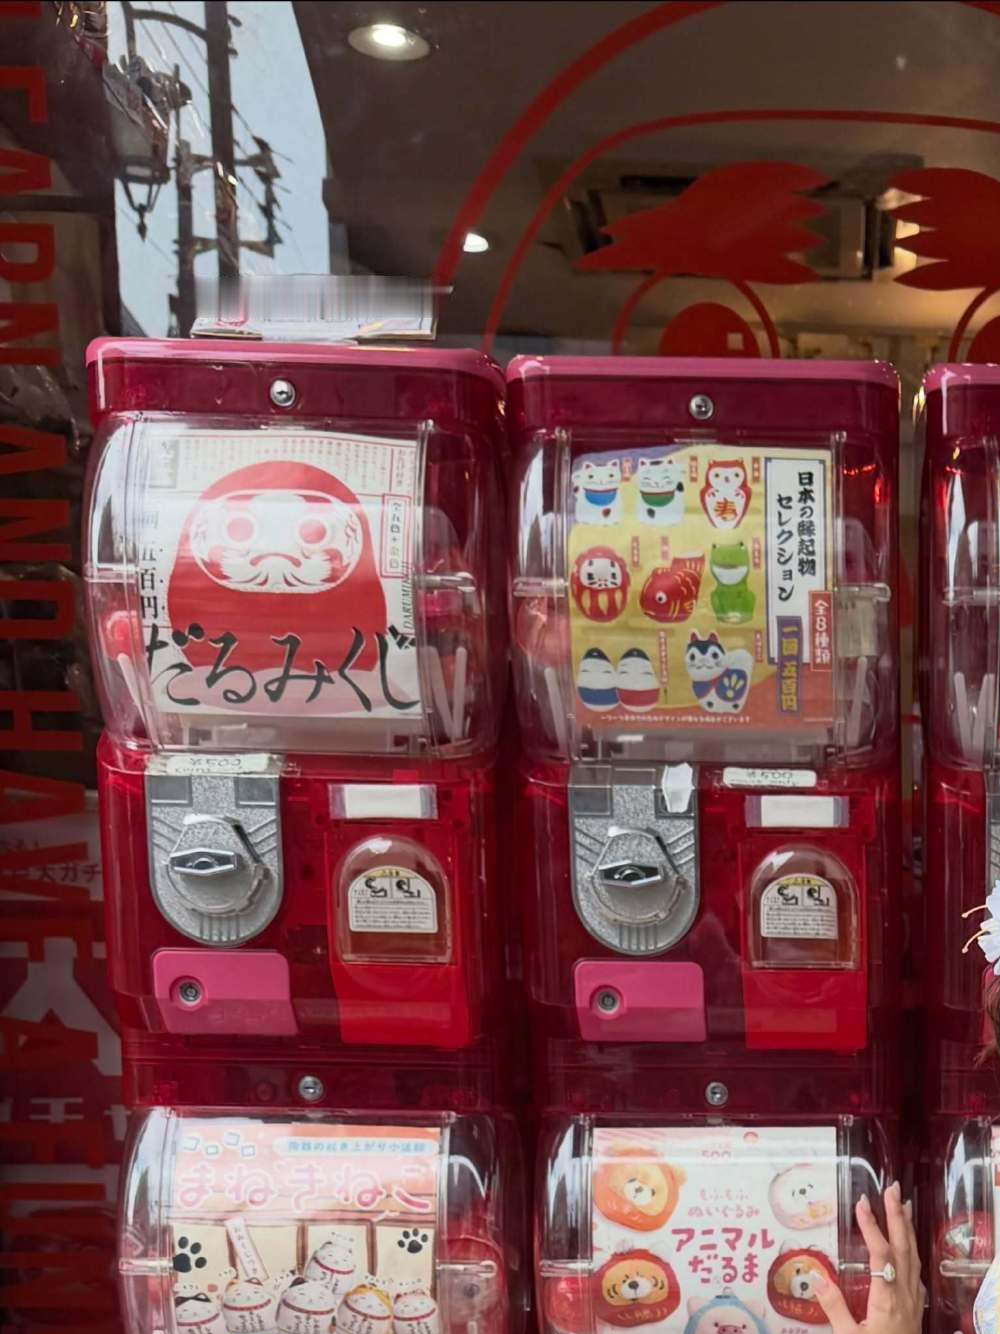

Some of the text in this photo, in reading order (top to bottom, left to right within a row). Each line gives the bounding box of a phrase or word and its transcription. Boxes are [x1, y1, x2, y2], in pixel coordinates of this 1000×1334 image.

[777, 493, 795, 602] セレクション
[797, 471, 816, 576] 日本の縁起物
[146, 624, 420, 712] だるみくじ
[671, 1228, 776, 1252] アニマル
[687, 1206, 760, 1220] ぬいぐるみ
[688, 1253, 760, 1284] だるま
